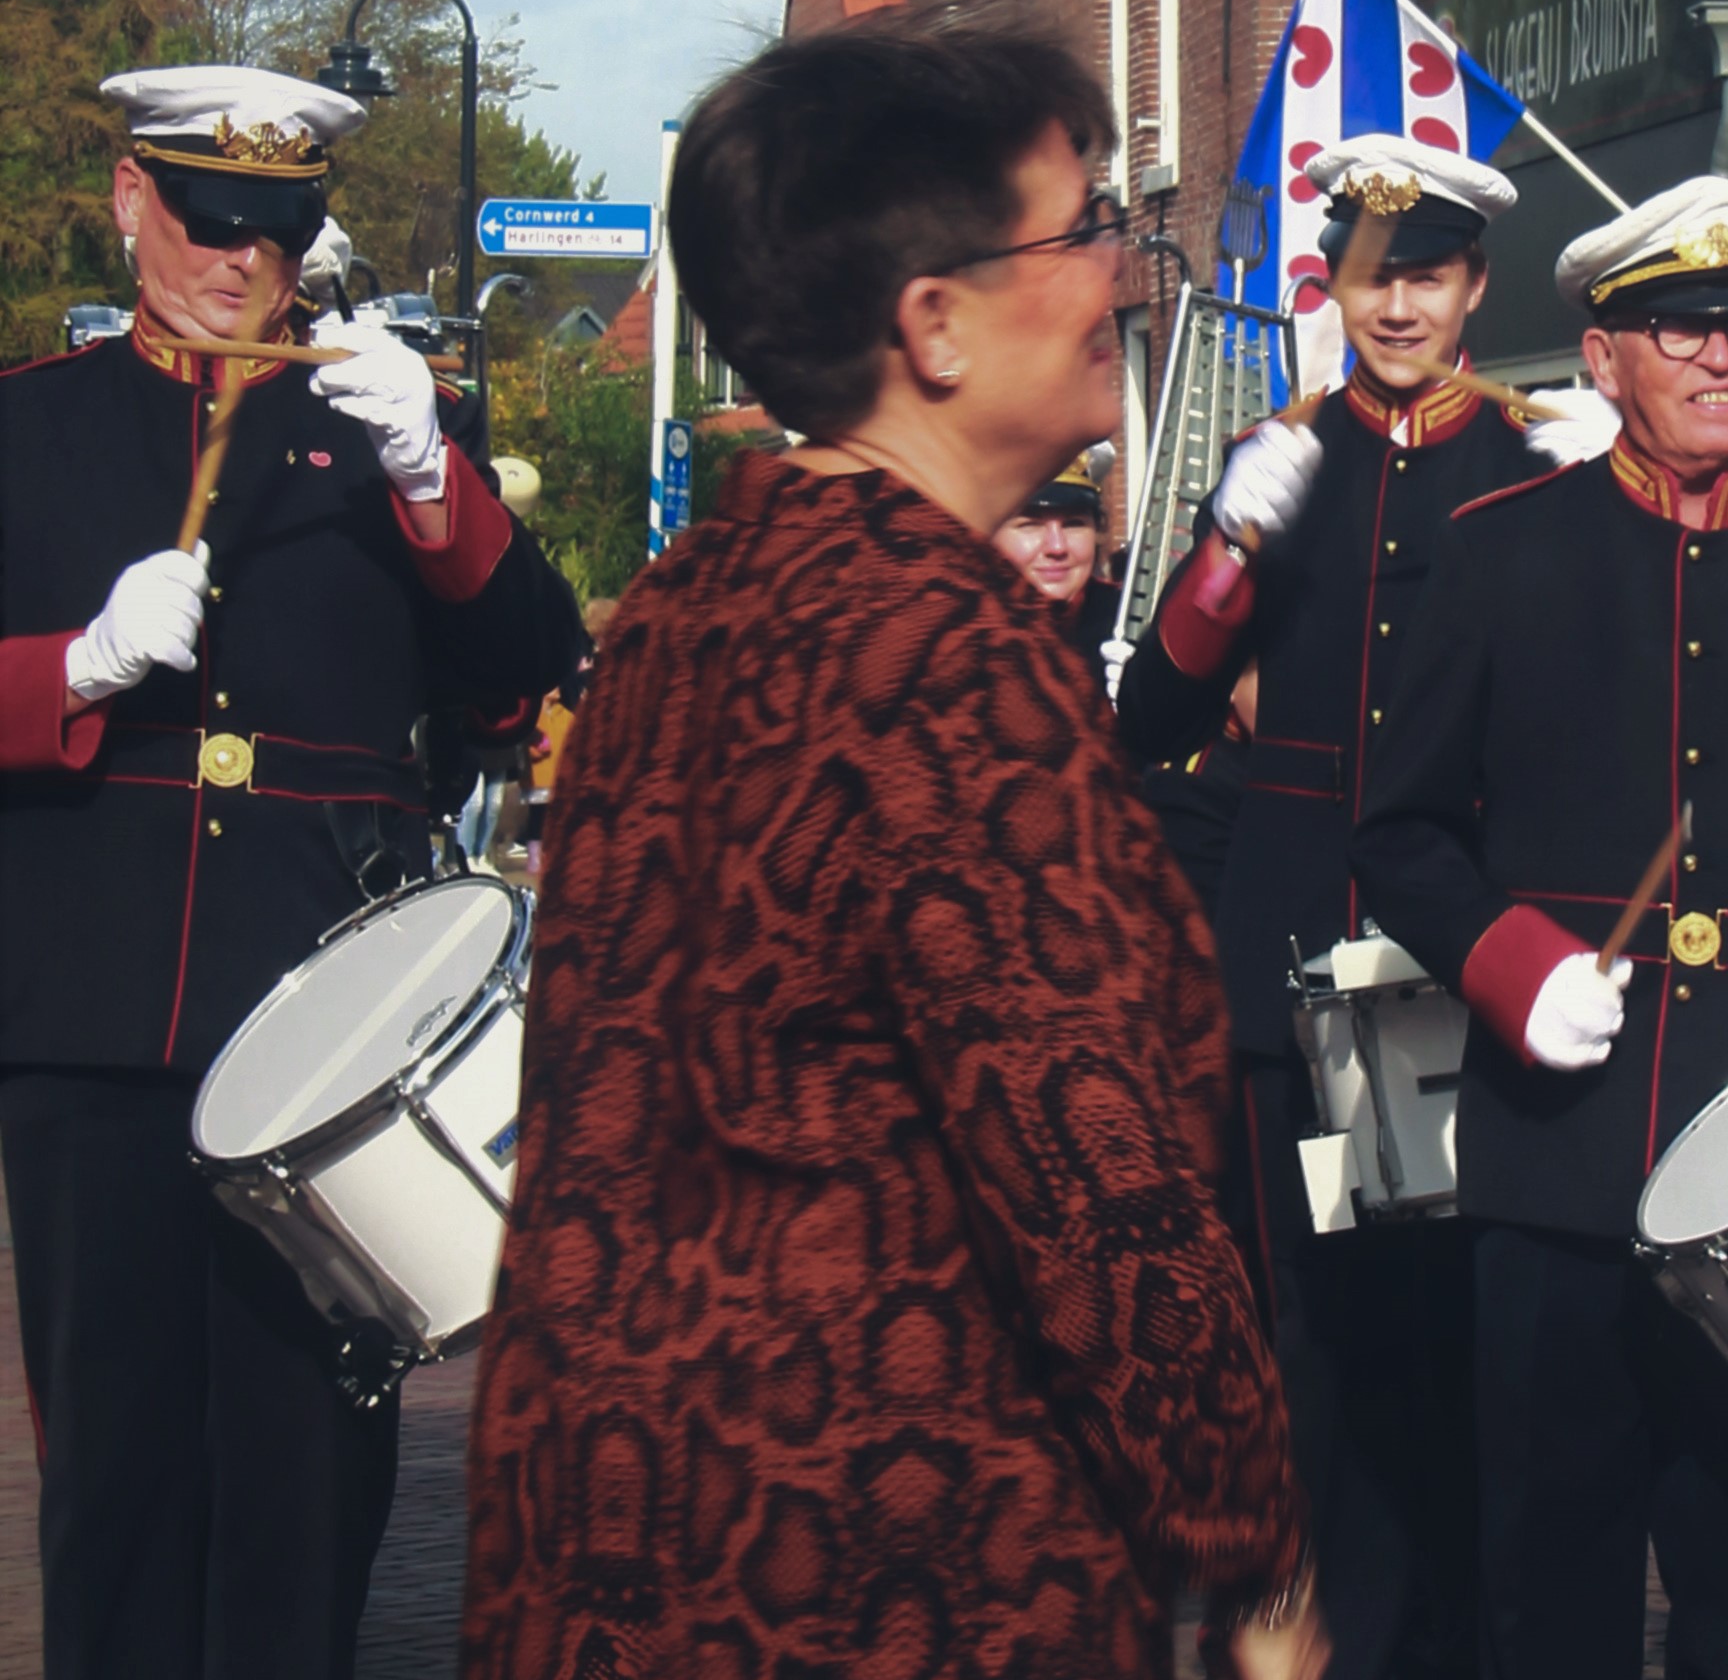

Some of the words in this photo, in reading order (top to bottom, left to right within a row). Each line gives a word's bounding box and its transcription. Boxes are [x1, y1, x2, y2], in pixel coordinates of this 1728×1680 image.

[504, 206, 580, 223] Cornwerd
[585, 211, 594, 223] 4
[507, 231, 582, 247] Harlingen
